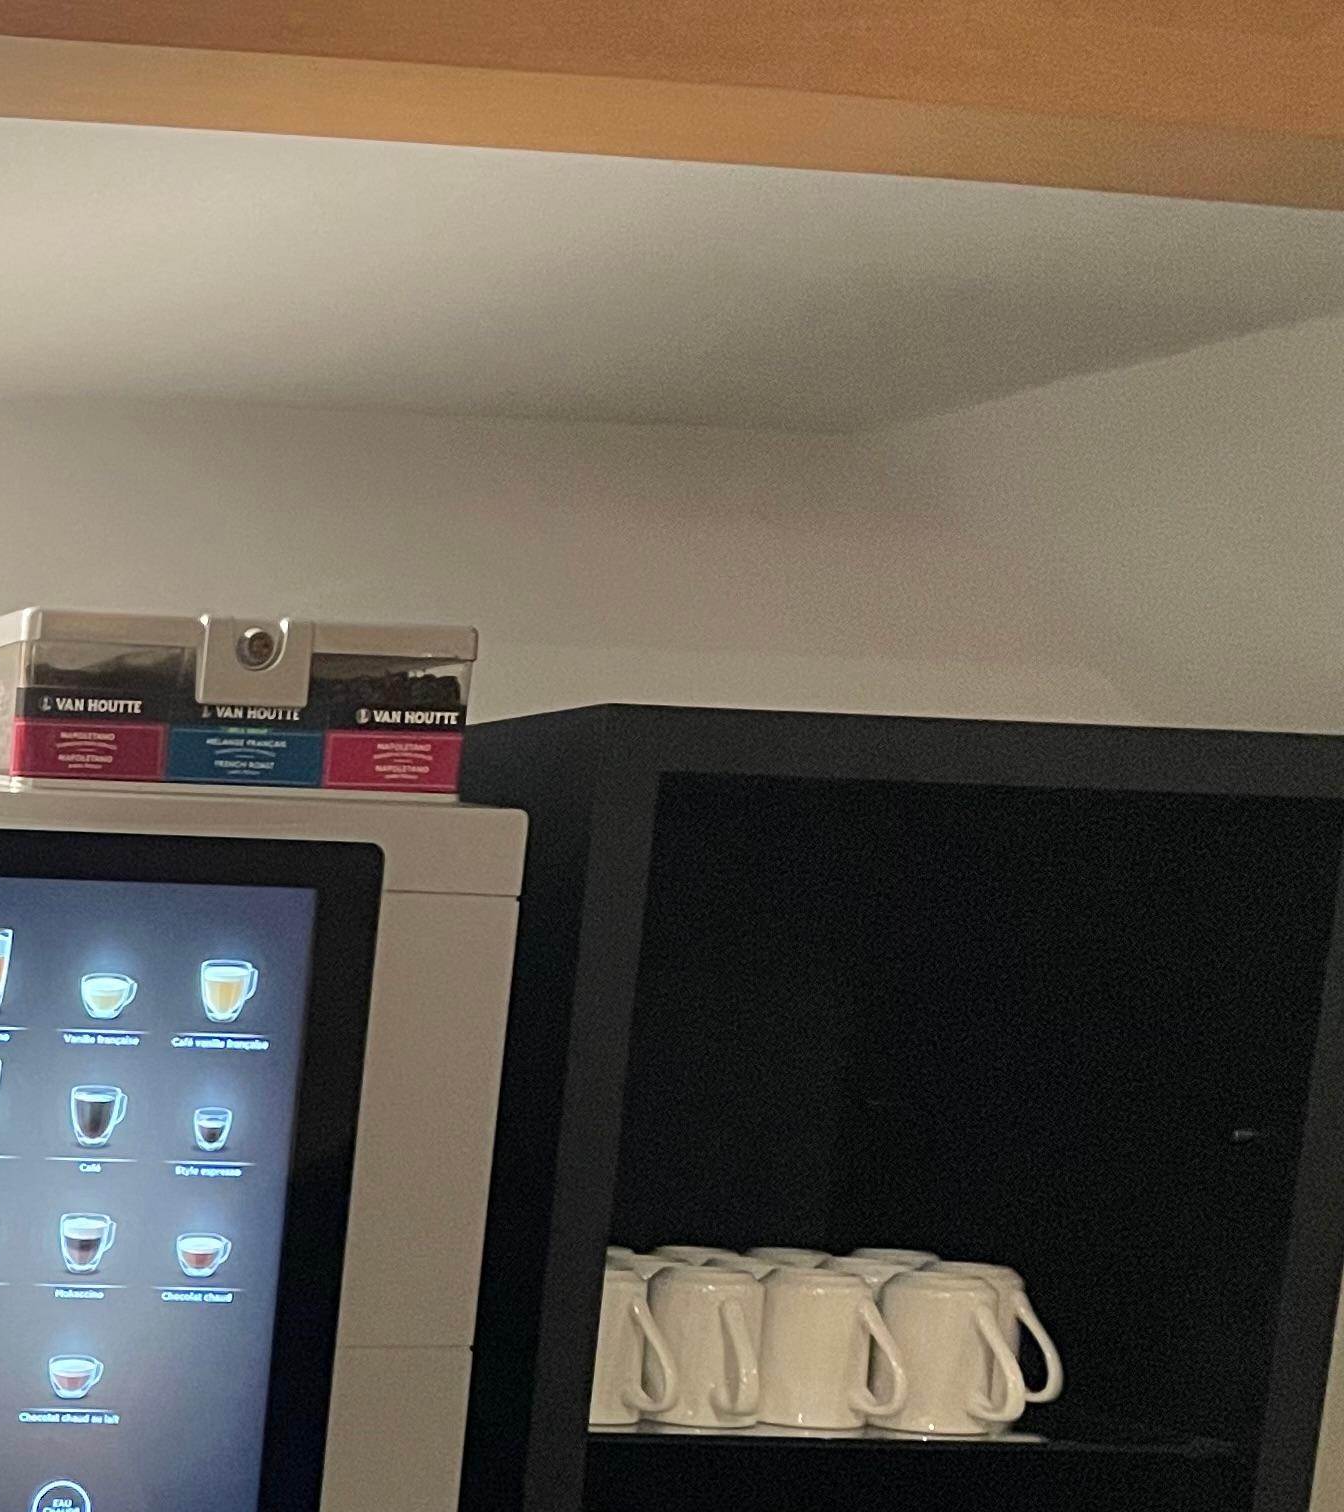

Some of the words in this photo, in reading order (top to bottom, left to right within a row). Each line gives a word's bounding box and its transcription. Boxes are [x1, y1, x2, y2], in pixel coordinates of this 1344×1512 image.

[56, 697, 84, 711] VAN
[87, 699, 142, 713] HOUTTE
[216, 707, 243, 719] VAN
[246, 708, 300, 721] HOUTTE
[373, 710, 401, 723] VAN
[404, 711, 459, 724] HOUTTE
